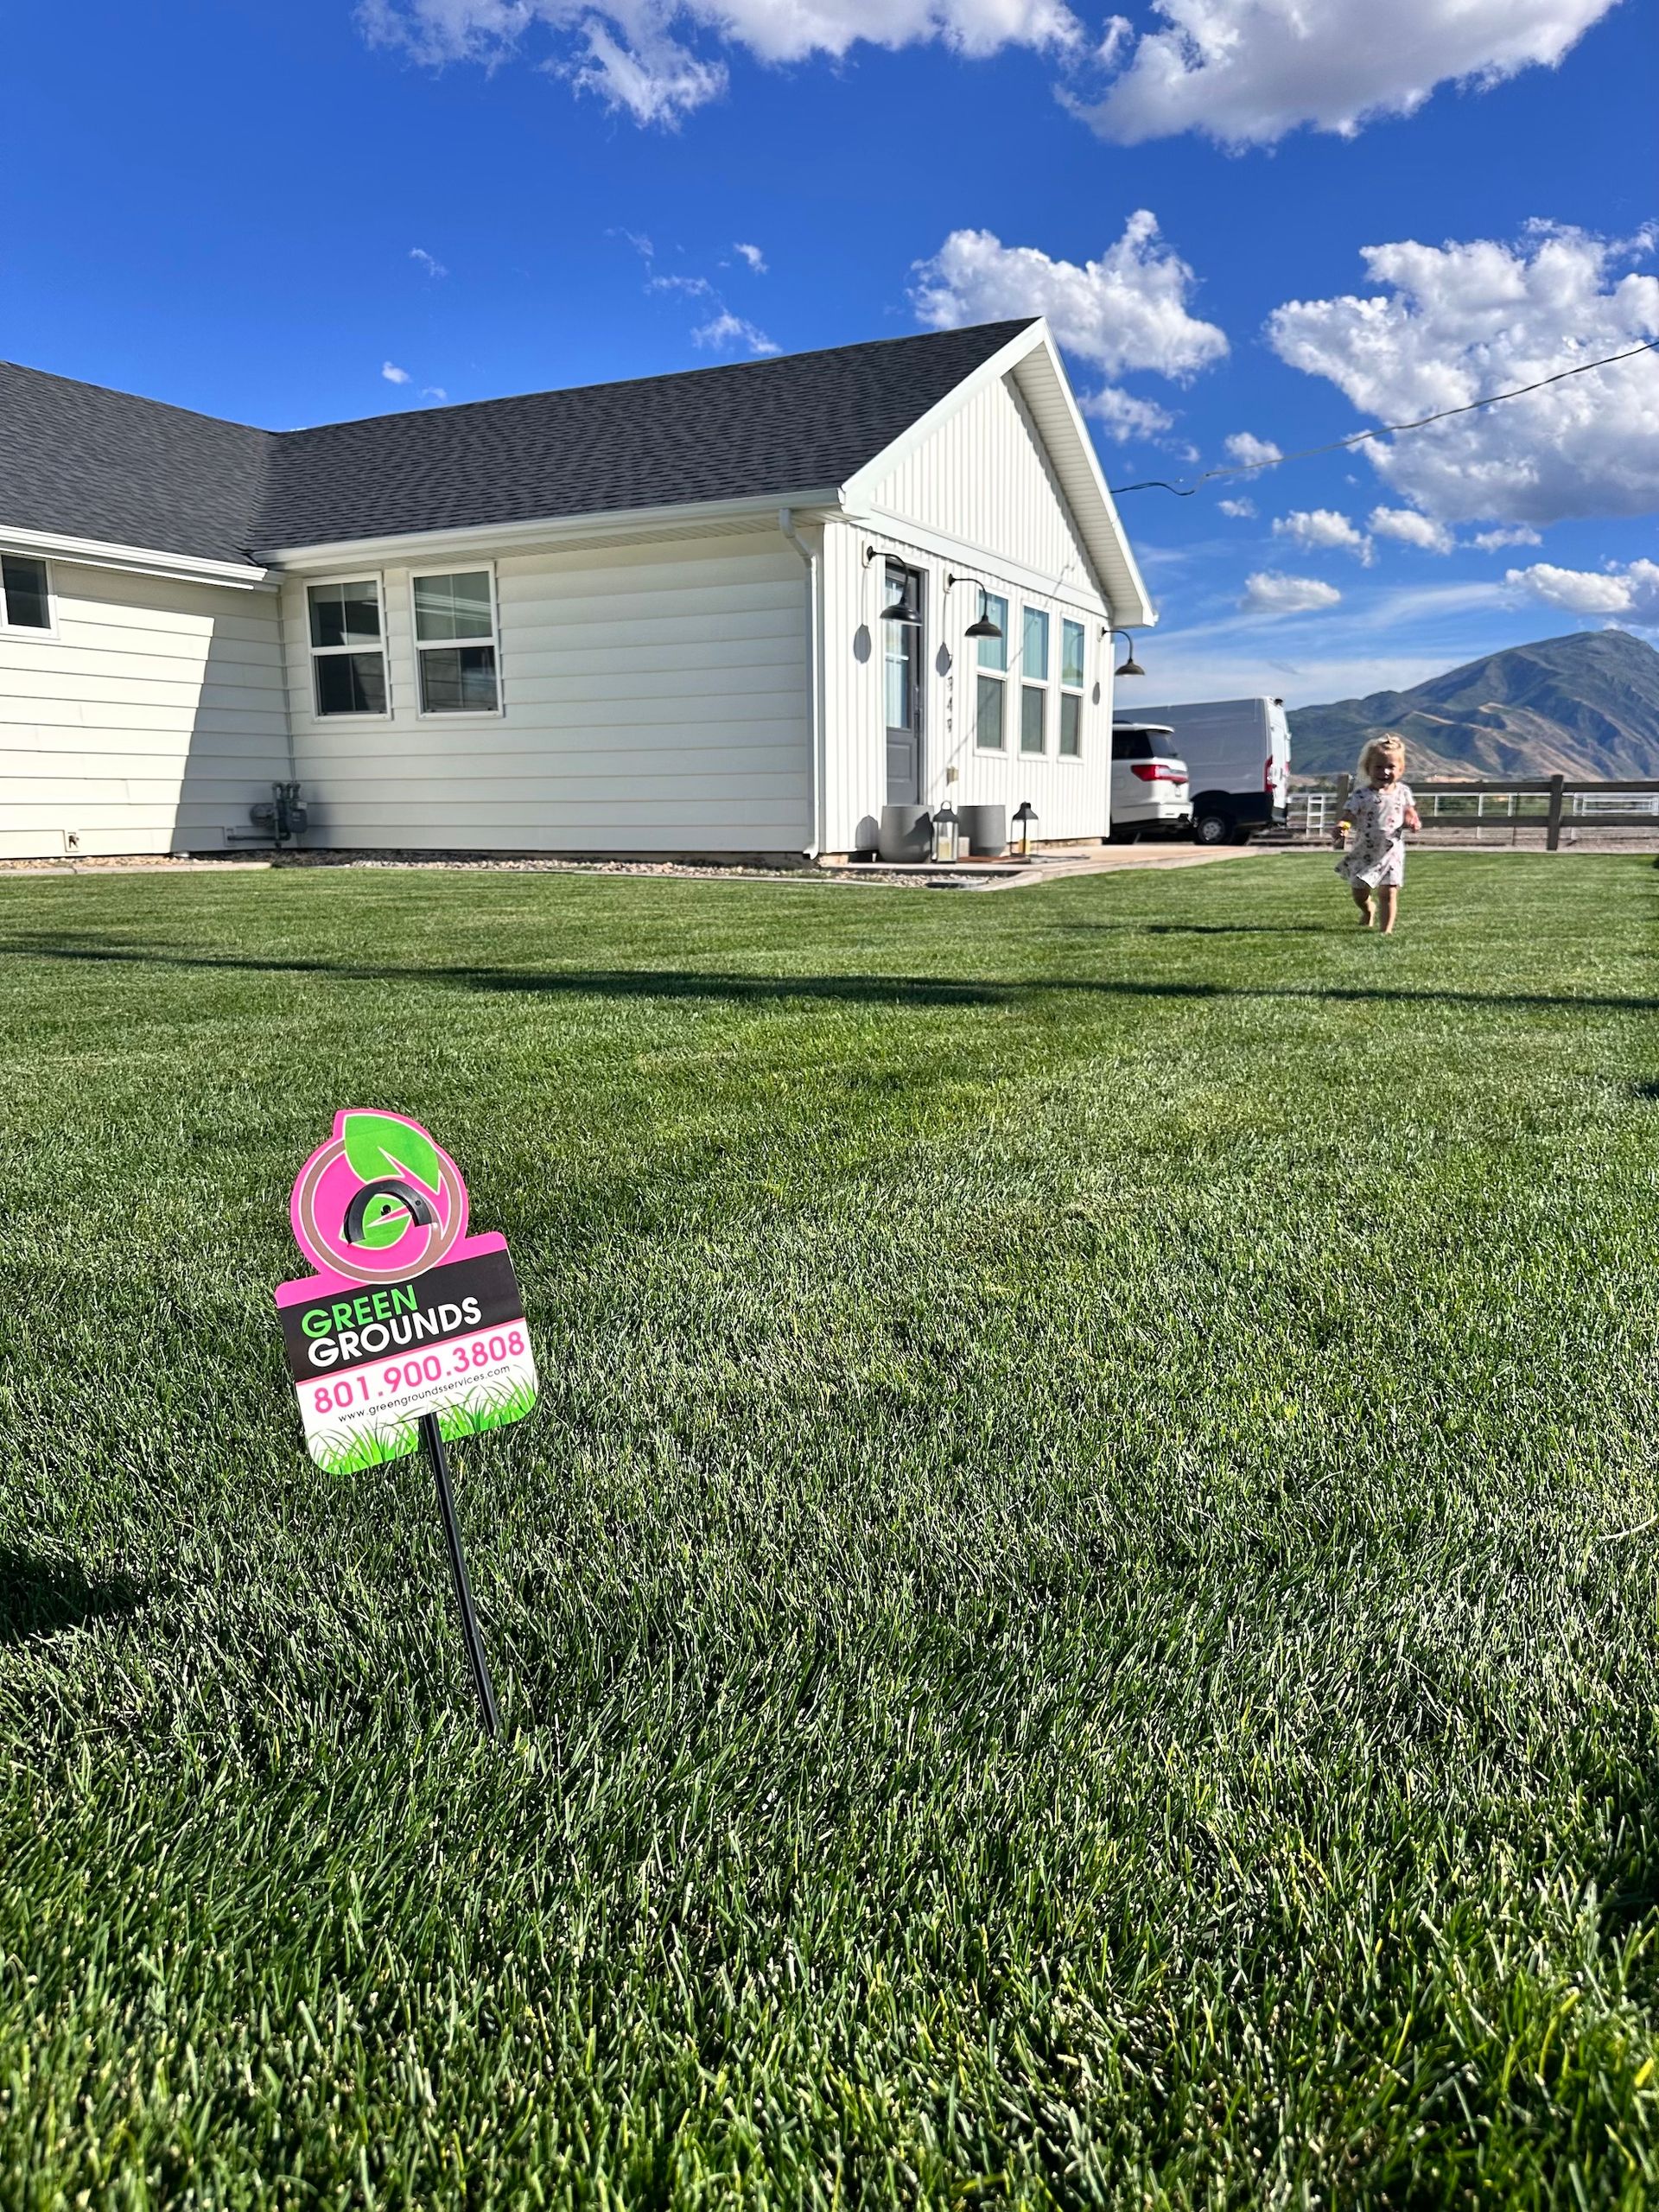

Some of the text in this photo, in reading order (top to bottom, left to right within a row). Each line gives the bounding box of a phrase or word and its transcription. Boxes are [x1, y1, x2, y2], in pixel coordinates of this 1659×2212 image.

[301, 1284, 418, 1338] GREEN
[308, 1296, 482, 1368] GROUNDS
[314, 1331, 524, 1414] 801.900.3808
[338, 1365, 510, 1423] www.greengroundsservices.com
